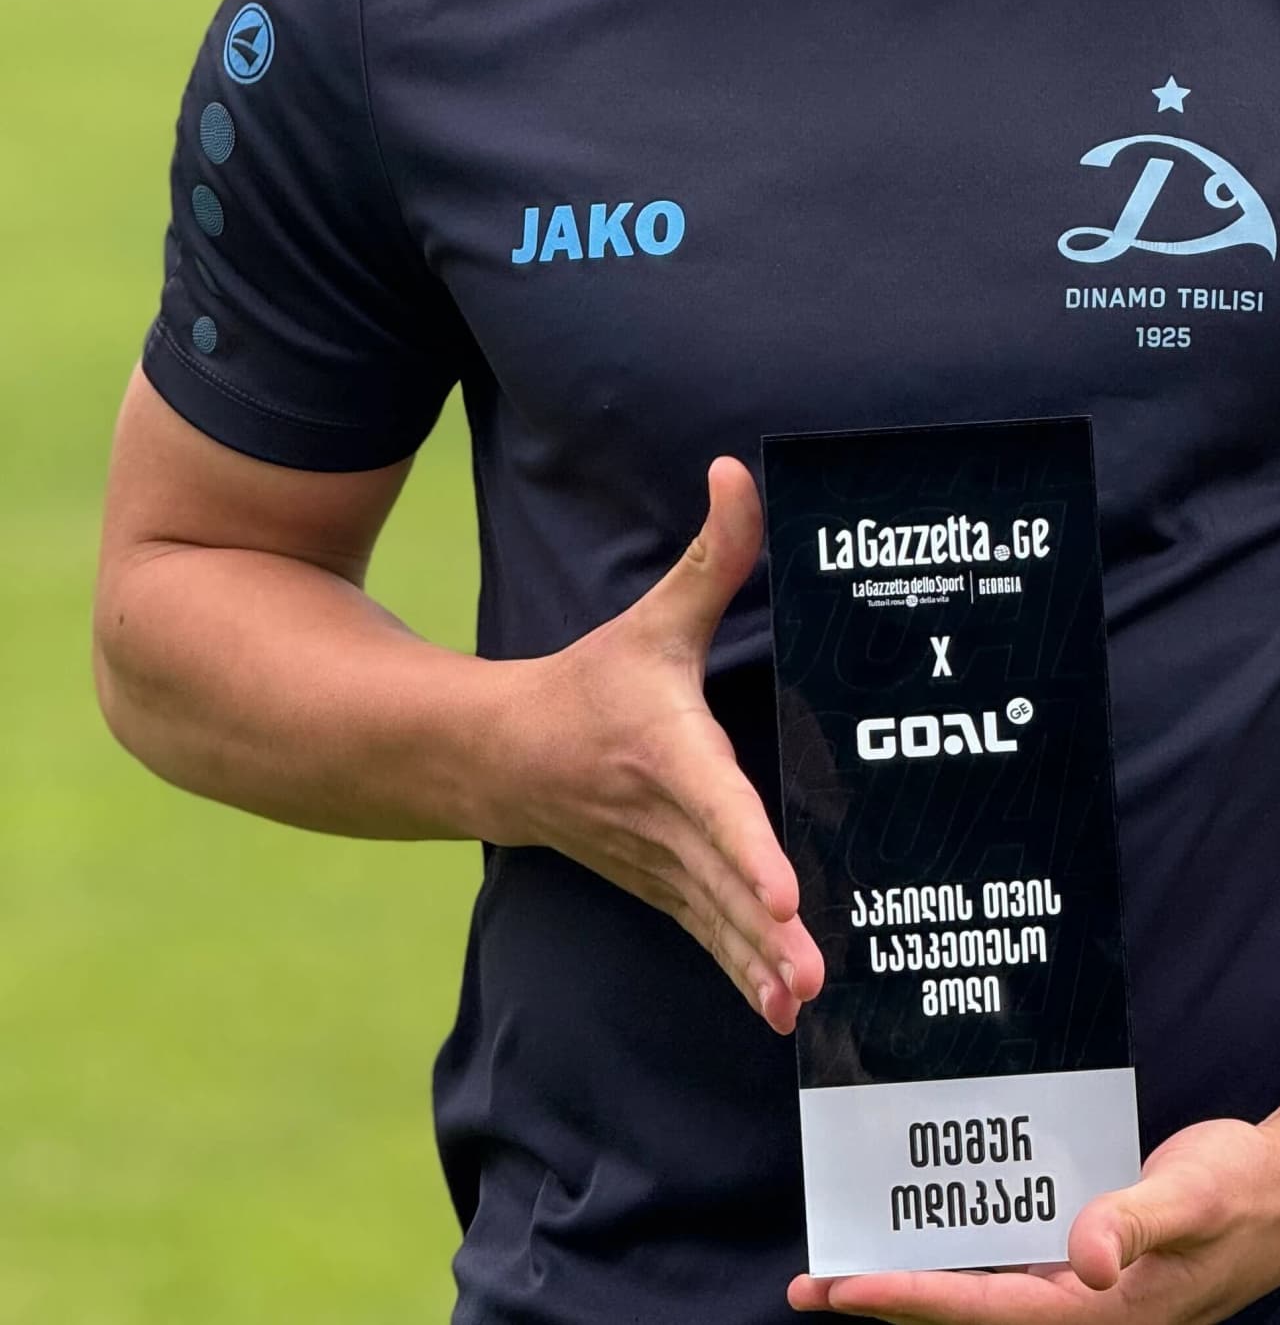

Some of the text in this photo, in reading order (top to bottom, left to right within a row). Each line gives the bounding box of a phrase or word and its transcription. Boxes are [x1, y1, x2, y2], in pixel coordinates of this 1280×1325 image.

[511, 200, 686, 264] JAKO
[1064, 287, 1264, 312] DINAMO TBILISI
[1135, 326, 1191, 348] 1925
[979, 576, 1022, 595] GEORGIA
[856, 711, 1018, 760] GOAL
